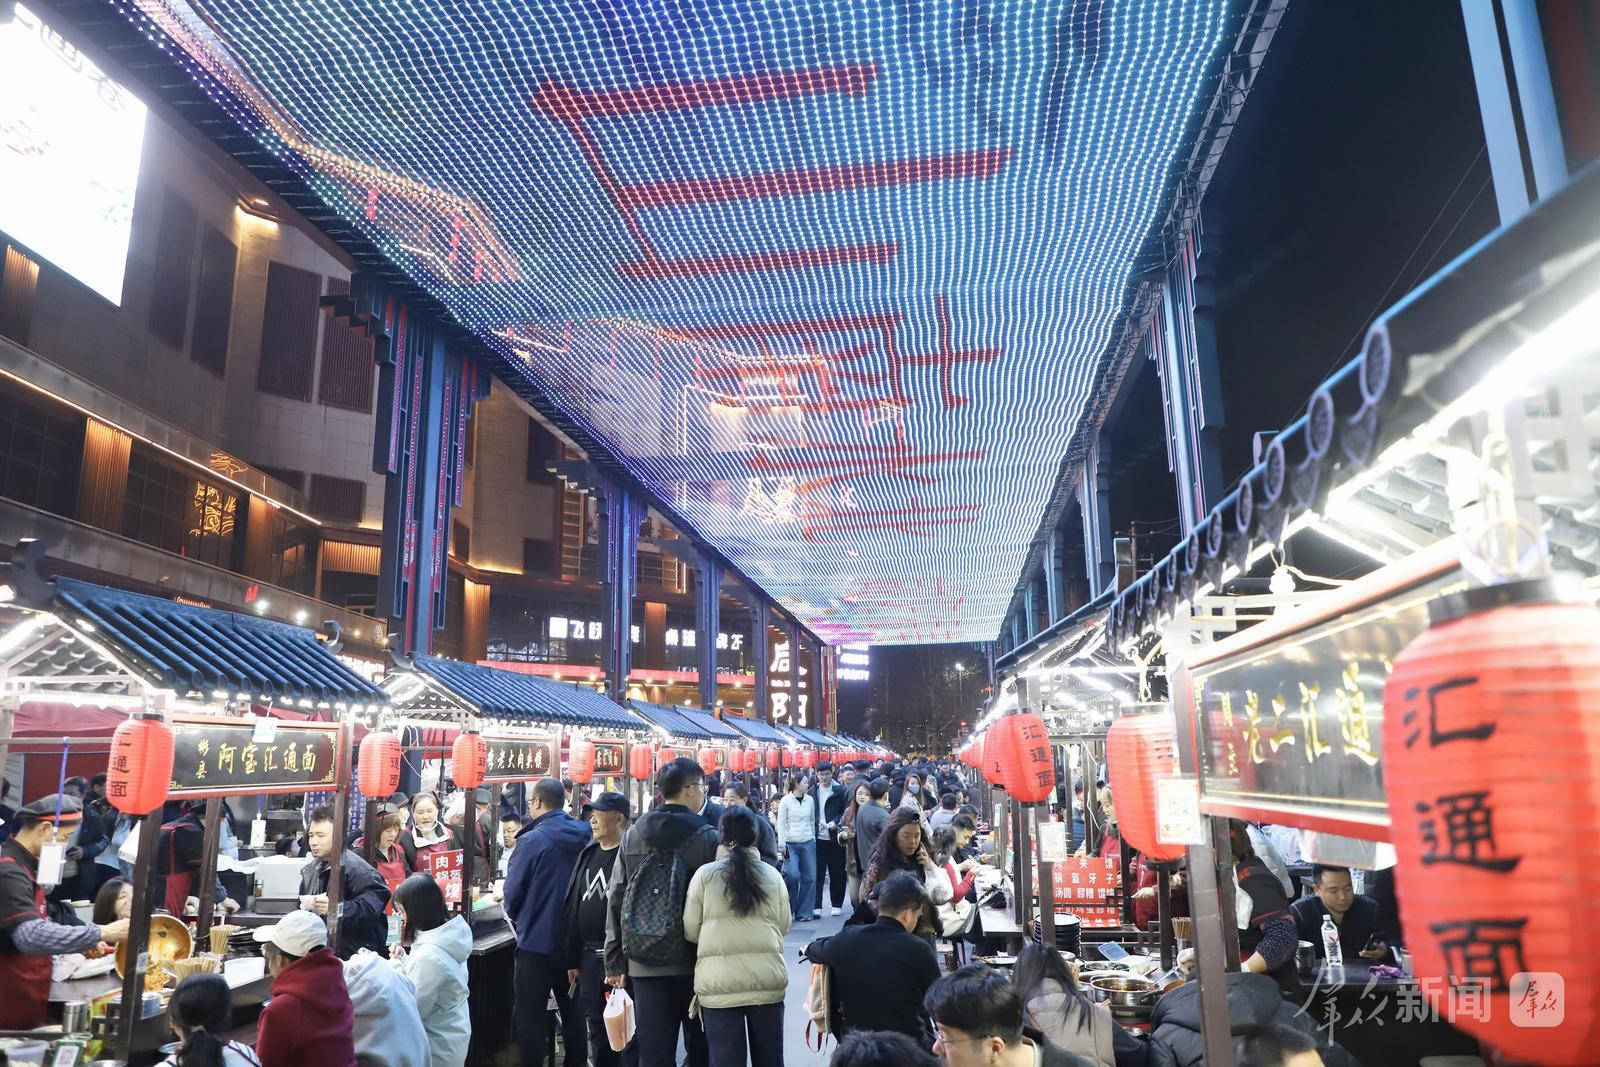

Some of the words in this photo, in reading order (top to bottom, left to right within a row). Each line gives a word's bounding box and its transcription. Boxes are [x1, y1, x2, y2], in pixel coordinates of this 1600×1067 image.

[218, 741, 317, 775] 阿宝汇通面
[1022, 724, 1052, 788] 汇通面
[1404, 676, 1528, 993] 汇通面
[1055, 887, 1072, 899] 汤圆
